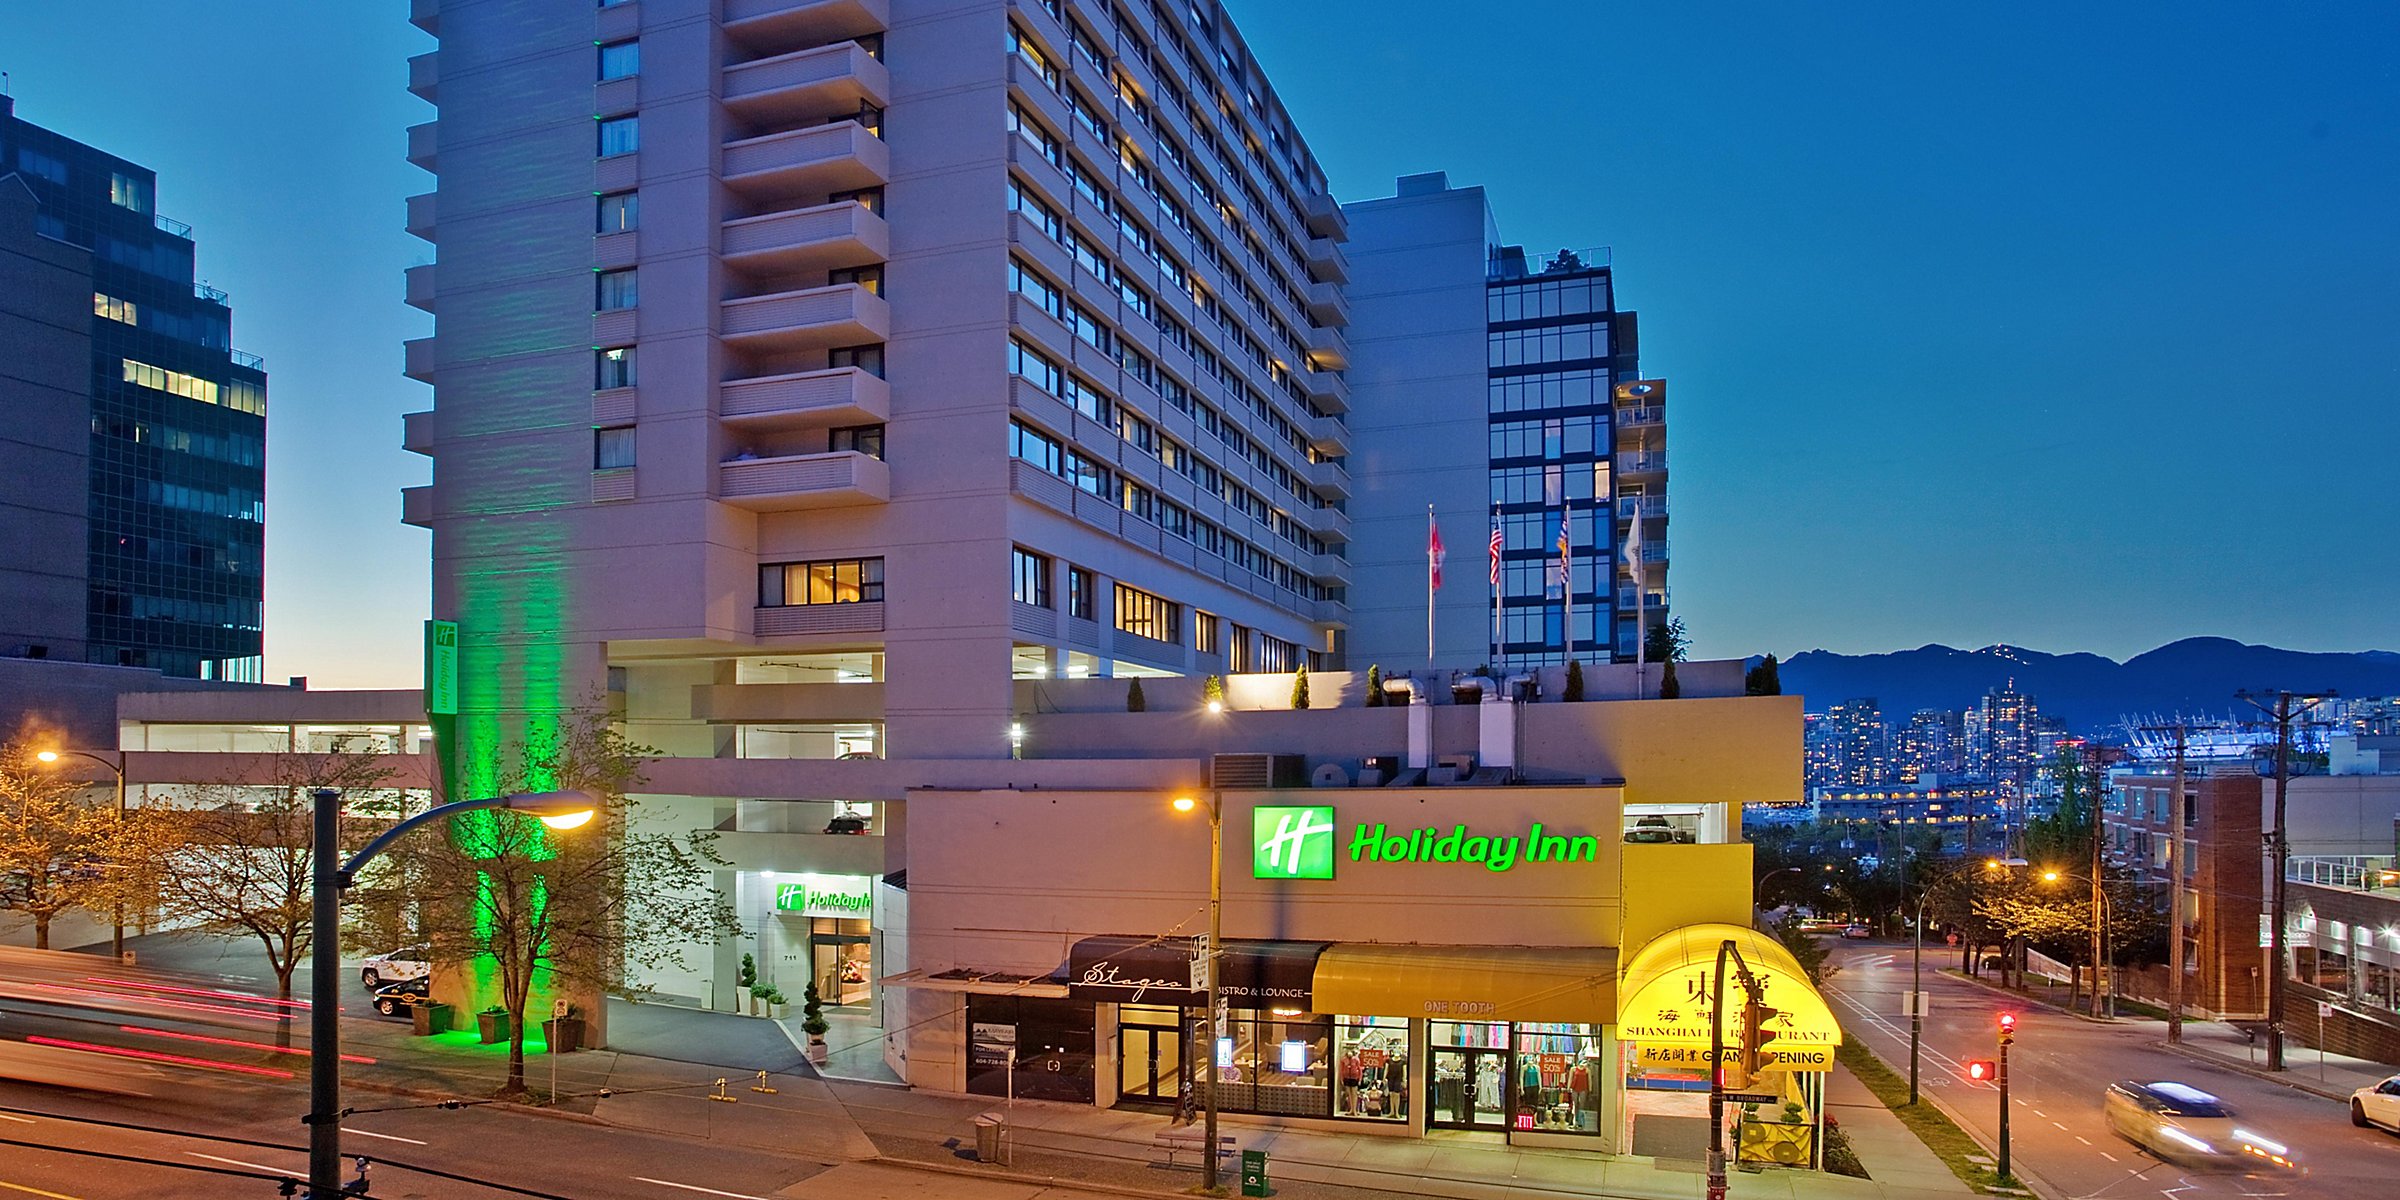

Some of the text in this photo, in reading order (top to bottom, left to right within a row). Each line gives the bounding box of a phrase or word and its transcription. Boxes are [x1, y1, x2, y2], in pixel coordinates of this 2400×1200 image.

[439, 649, 451, 709] Holiday Inn
[1348, 822, 1598, 873] Holiday Inn
[807, 891, 871, 910] Holiday In
[1079, 961, 1182, 1003] Stages
[1250, 987, 1258, 997] &
[1260, 987, 1304, 998] LOUNGE
[1424, 1000, 1495, 1015] ONE TOOTH
[1626, 1026, 1702, 1038] SHANGHAI
[1543, 1056, 1561, 1064] SALE
[1736, 1095, 1768, 1103] BROADWAY
